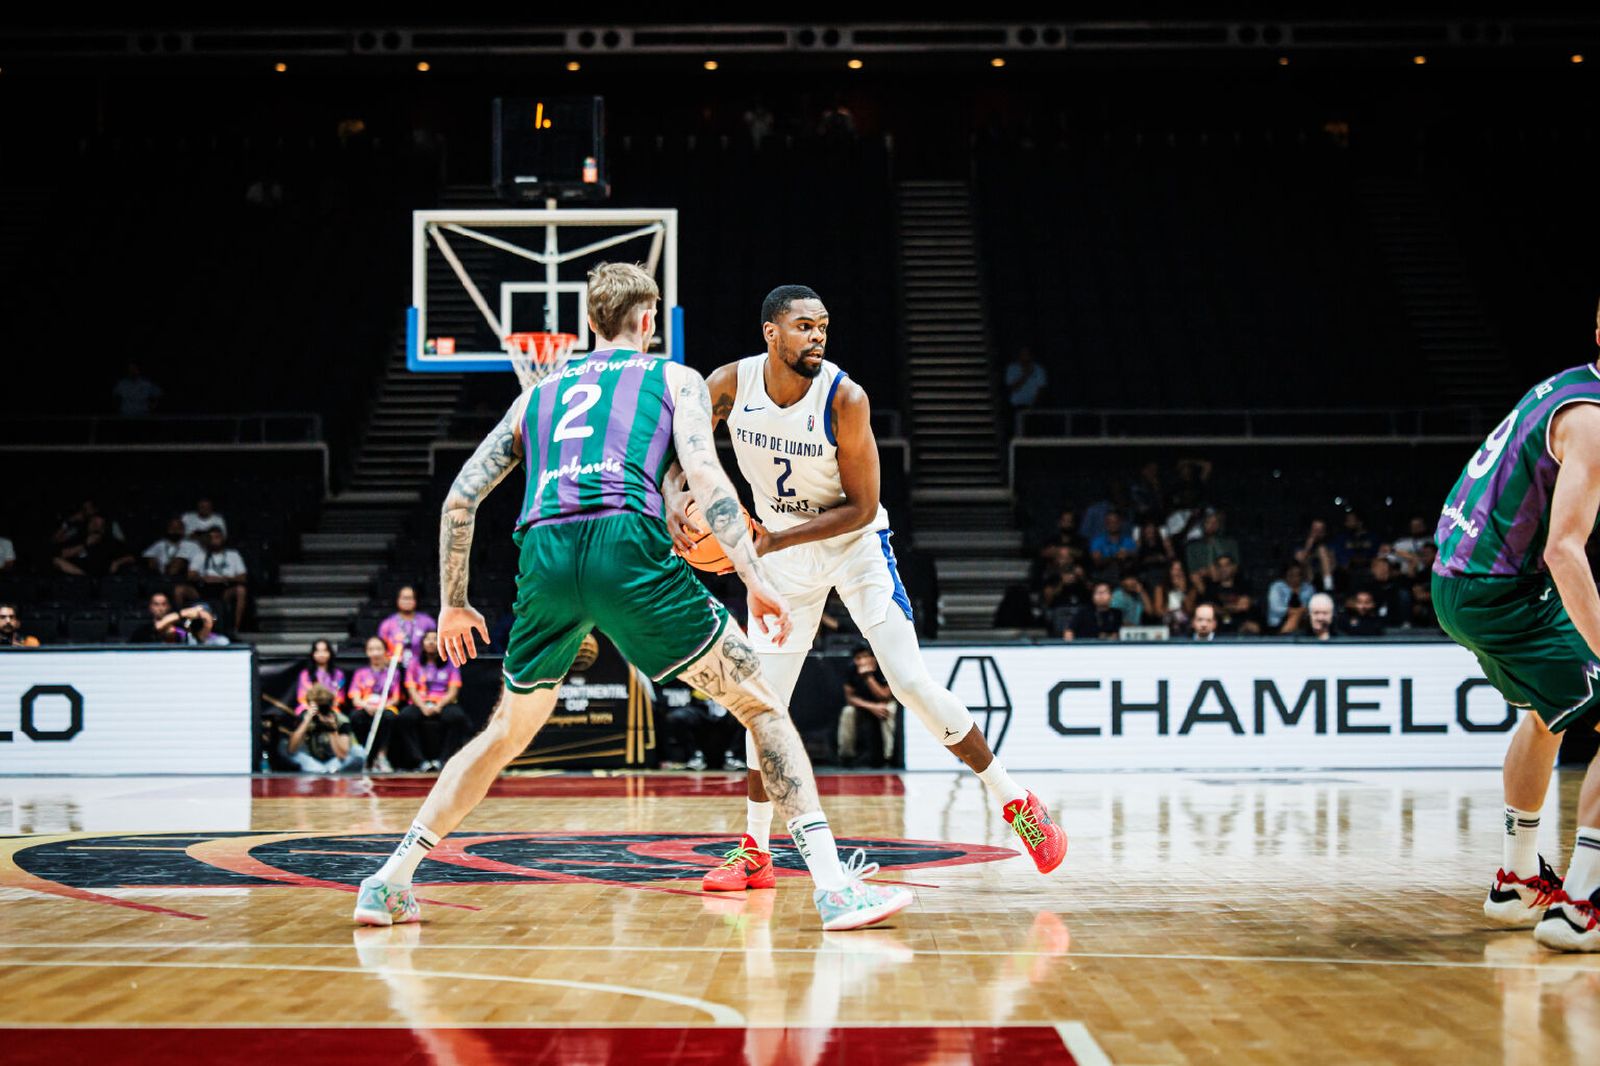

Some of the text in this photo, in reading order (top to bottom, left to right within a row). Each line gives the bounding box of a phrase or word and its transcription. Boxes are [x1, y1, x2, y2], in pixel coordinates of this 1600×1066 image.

[553, 383, 602, 443] 2
[736, 428, 823, 457] PETRO DE LUANDA
[1467, 408, 1519, 479] 9
[773, 457, 796, 497] 2
[0, 684, 84, 742] O
[1047, 677, 1518, 737] CHAMELO
